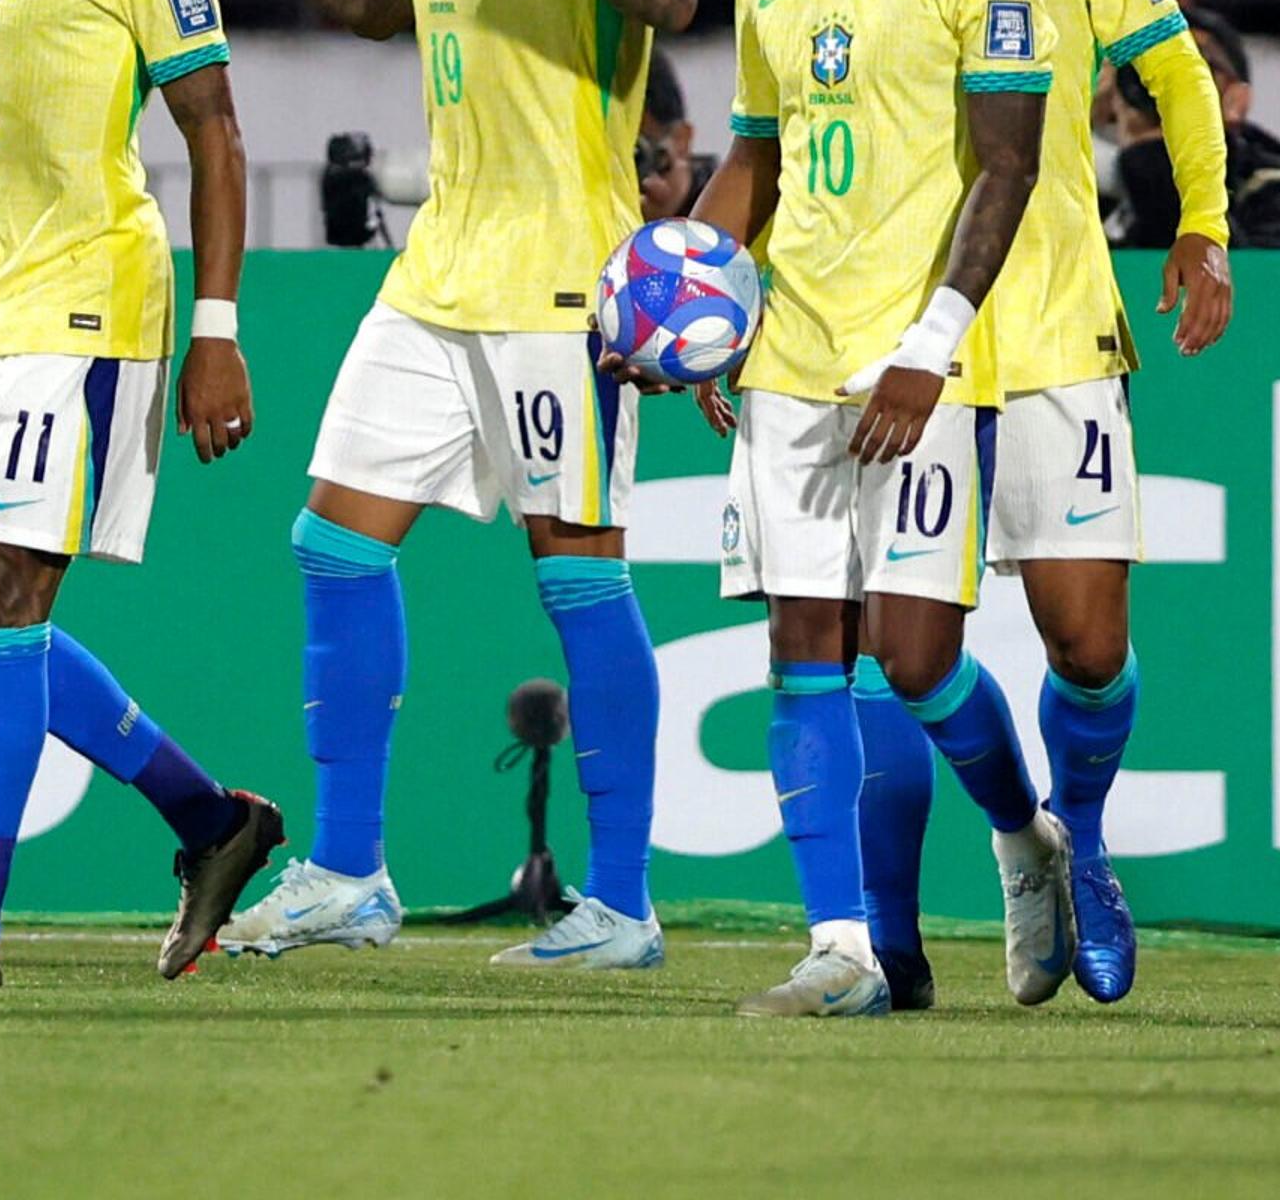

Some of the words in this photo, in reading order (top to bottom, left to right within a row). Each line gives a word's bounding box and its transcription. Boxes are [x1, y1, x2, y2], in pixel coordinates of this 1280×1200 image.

[431, 32, 463, 107] 19
[808, 92, 854, 105] BRASIL
[808, 119, 854, 196] 10
[4, 409, 55, 483] 11
[515, 389, 564, 462] 19
[1075, 419, 1112, 493] 4
[896, 461, 953, 538] 10
